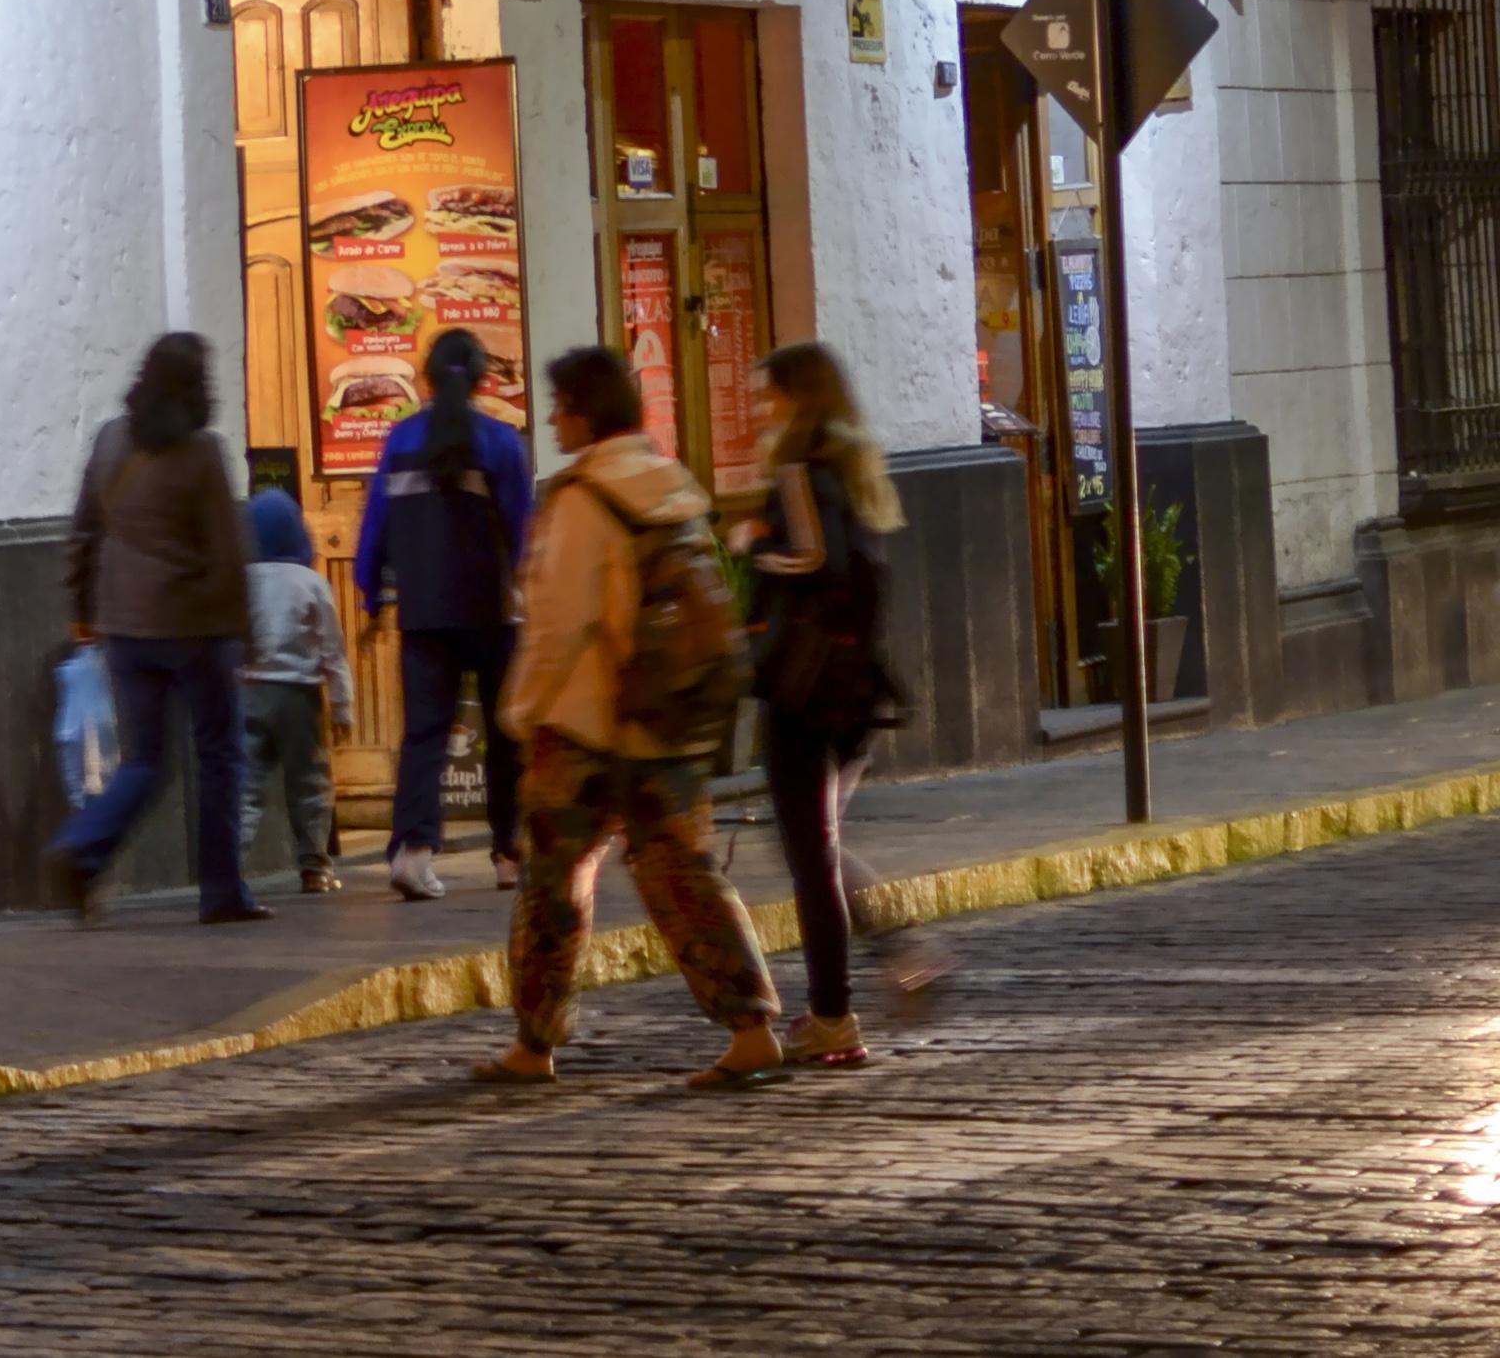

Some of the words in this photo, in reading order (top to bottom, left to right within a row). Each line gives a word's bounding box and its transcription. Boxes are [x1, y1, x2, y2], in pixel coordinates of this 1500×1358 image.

[1033, 50, 1058, 61] Cerro
[1059, 50, 1086, 61] Verde
[349, 85, 466, 136] Arequipa
[631, 159, 652, 177] VISA
